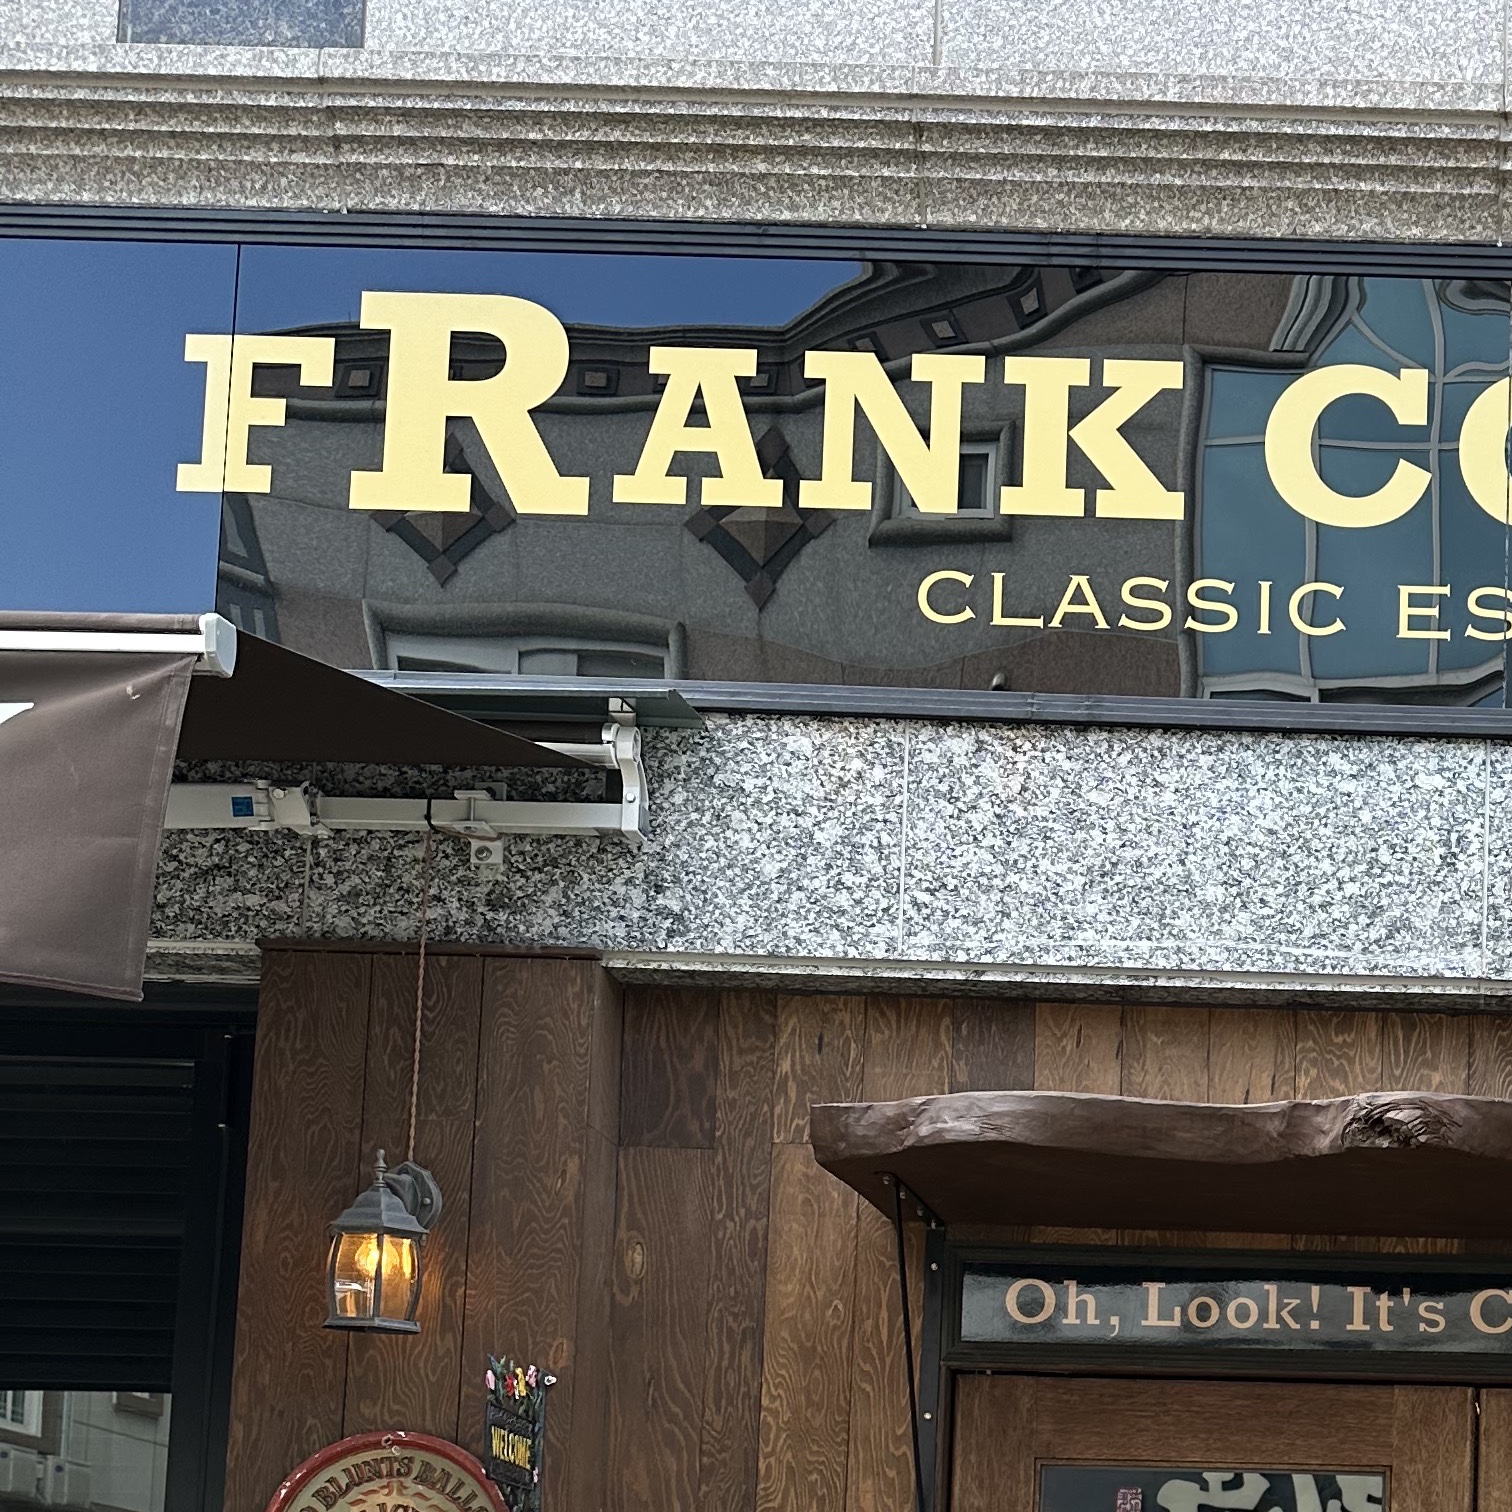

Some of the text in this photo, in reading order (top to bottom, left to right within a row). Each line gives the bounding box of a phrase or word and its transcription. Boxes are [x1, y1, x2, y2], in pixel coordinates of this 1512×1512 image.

[176, 290, 1185, 521] FRANK
[917, 569, 1347, 638] CLASSIC
[1004, 1278, 1121, 1336] Oh,
[1141, 1280, 1321, 1334] Look!
[1345, 1285, 1446, 1335] It's
[491, 1425, 532, 1471] WELCOME
